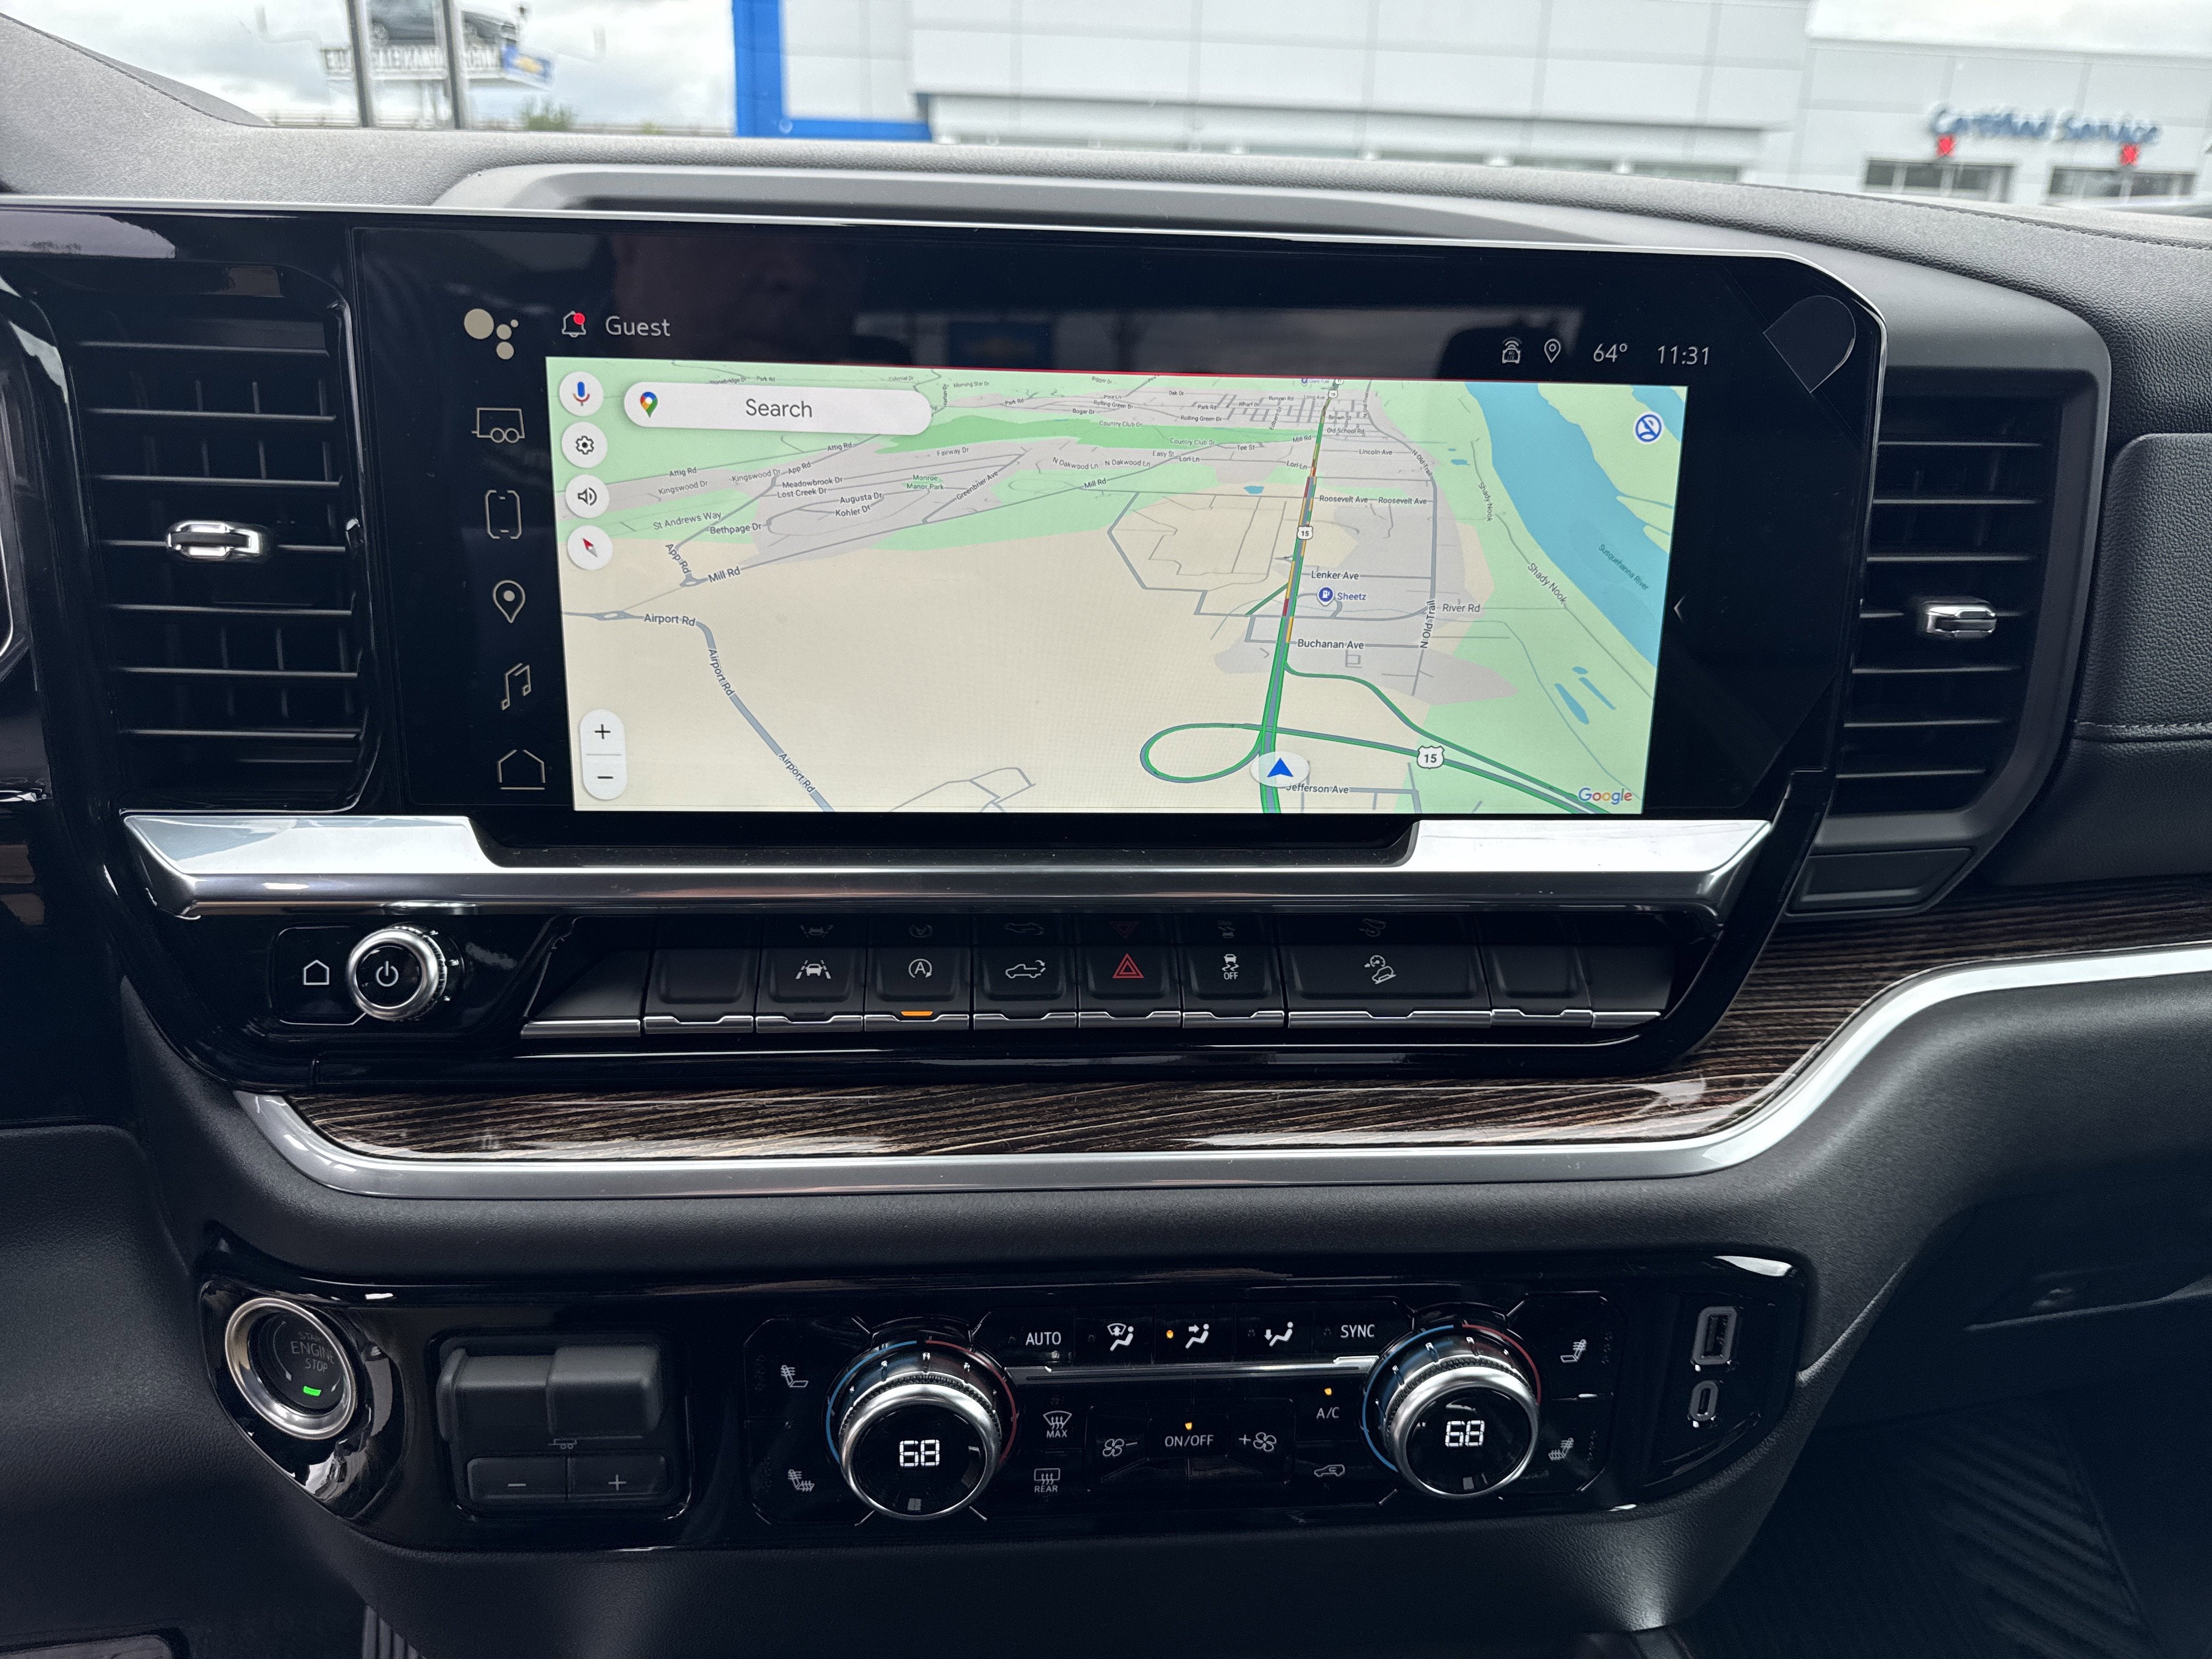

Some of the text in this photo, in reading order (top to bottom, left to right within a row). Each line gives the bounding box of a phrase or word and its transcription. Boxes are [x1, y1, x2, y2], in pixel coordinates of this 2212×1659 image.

[606, 316, 670, 336] Guest
[1594, 342, 1628, 363] 64°
[1658, 346, 1710, 365] 11:31
[746, 399, 812, 417] Search
[828, 444, 842, 452] Attig
[788, 461, 811, 475] App Rd
[1059, 459, 1089, 469] Oakwood
[1417, 455, 1426, 464] Old
[1424, 463, 1433, 477] Trail
[732, 471, 771, 483] Kingswood
[782, 478, 833, 488] Meadowbrook
[1084, 478, 1106, 489] Mill Rd
[658, 482, 698, 495] Kingswood
[956, 470, 998, 500] Greenbrier Ave
[1478, 482, 1491, 502] Shady
[840, 494, 872, 504] Augusta
[836, 504, 871, 517] Kohler Dr
[653, 511, 721, 531] St Andrews Way
[710, 523, 761, 535] Bethpage Dr
[665, 544, 691, 574] App Rd
[1599, 544, 1649, 590] Susquehanna River
[708, 566, 741, 583] Mill Rd
[1312, 571, 1359, 580] Lenker Ave
[1528, 563, 1567, 604] Shady Nook
[1337, 591, 1366, 601] Sheetz
[1426, 600, 1435, 620] Trail
[1443, 603, 1480, 612] River Rd
[644, 613, 696, 627] Airport Rd
[1423, 623, 1432, 639] Old
[1297, 639, 1364, 650] Buchanan Ave
[708, 648, 735, 696] Airport Rd
[1424, 754, 1437, 763] 15
[779, 753, 815, 793] Airport Rd
[1332, 785, 1348, 793] Ave
[1578, 787, 1633, 804] Google
[1223, 972, 1238, 980] OFF
[1340, 1324, 1375, 1338] SYNC
[1026, 1331, 1062, 1346] AUTO
[291, 1341, 335, 1364] ENGINE
[305, 1358, 328, 1372] STOP
[1317, 1407, 1339, 1420] A/C
[1046, 1430, 1068, 1438] MAX
[1444, 1419, 1485, 1448] 68
[1165, 1434, 1214, 1449] ON/OFF
[899, 1439, 940, 1468] 68
[1034, 1485, 1058, 1493] REAR
